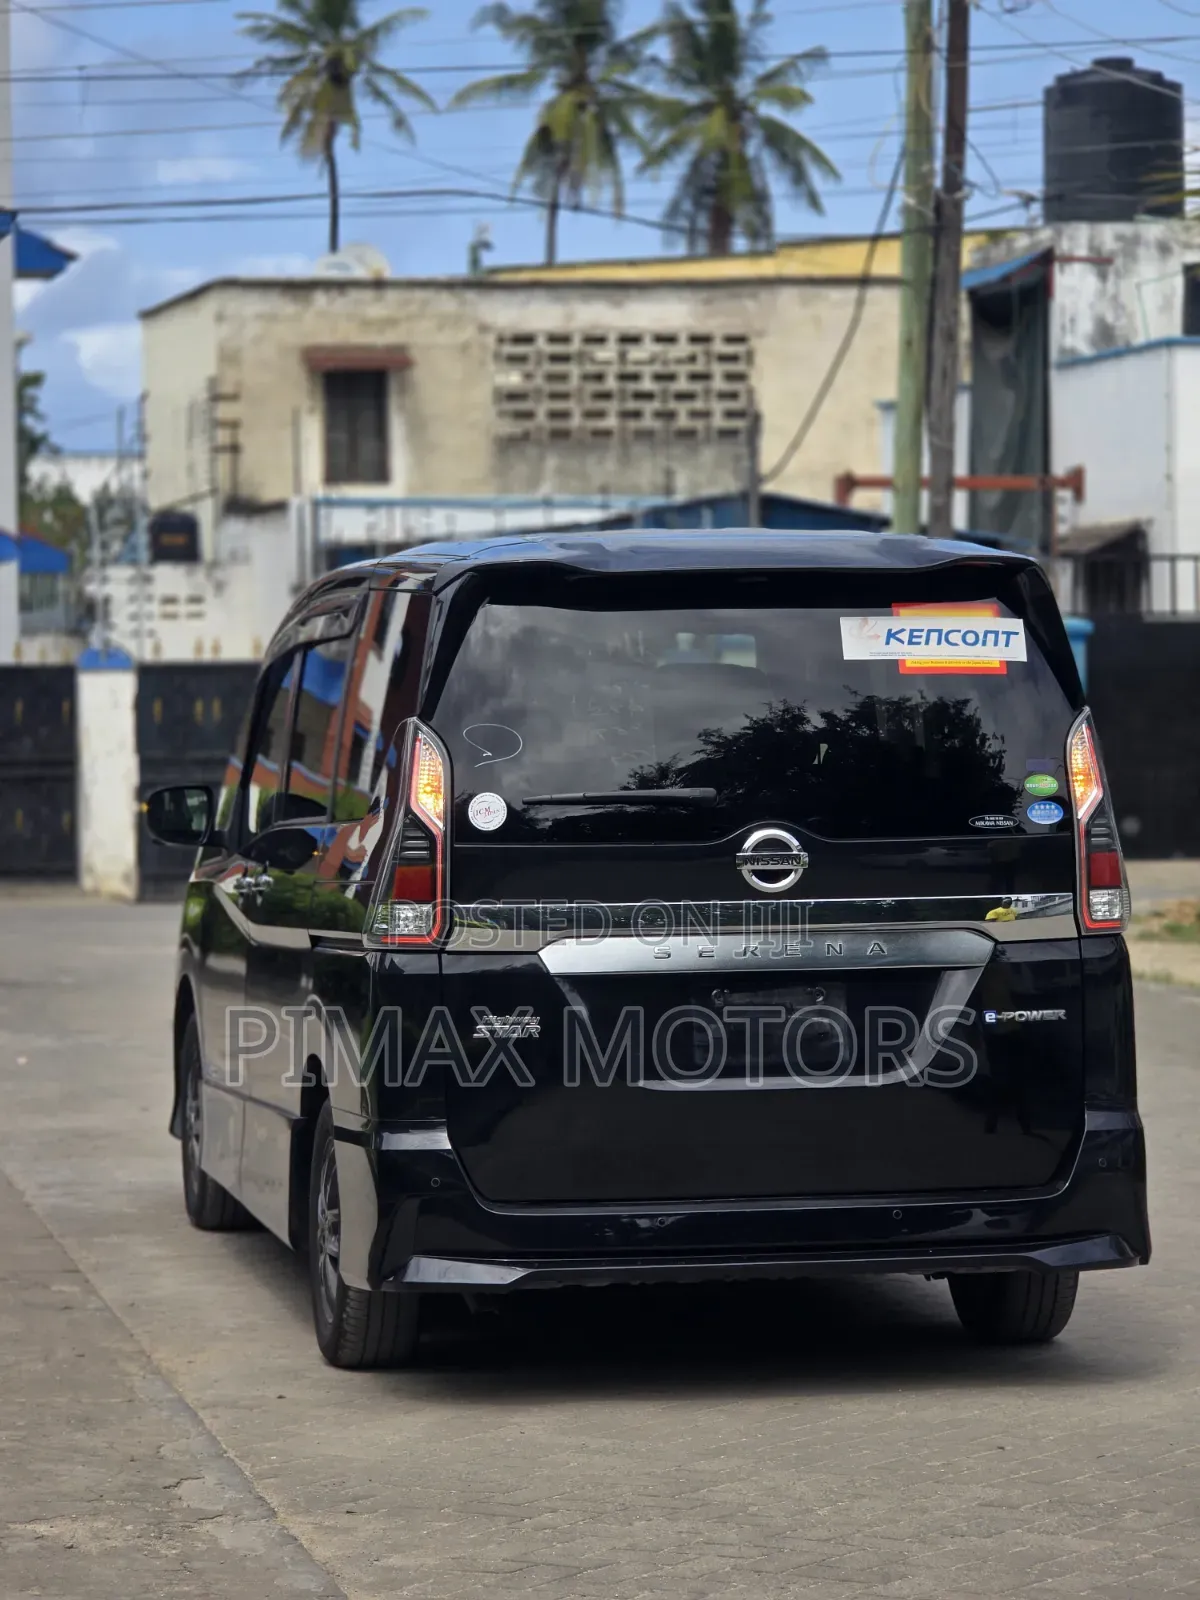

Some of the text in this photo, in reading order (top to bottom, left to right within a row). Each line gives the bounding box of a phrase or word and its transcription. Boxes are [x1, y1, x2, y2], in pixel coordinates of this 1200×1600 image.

[744, 856, 802, 866] NISSAN
[653, 941, 888, 960] SERENA
[984, 1009, 1067, 1023] e-POWER
[473, 1025, 541, 1038] STAR
